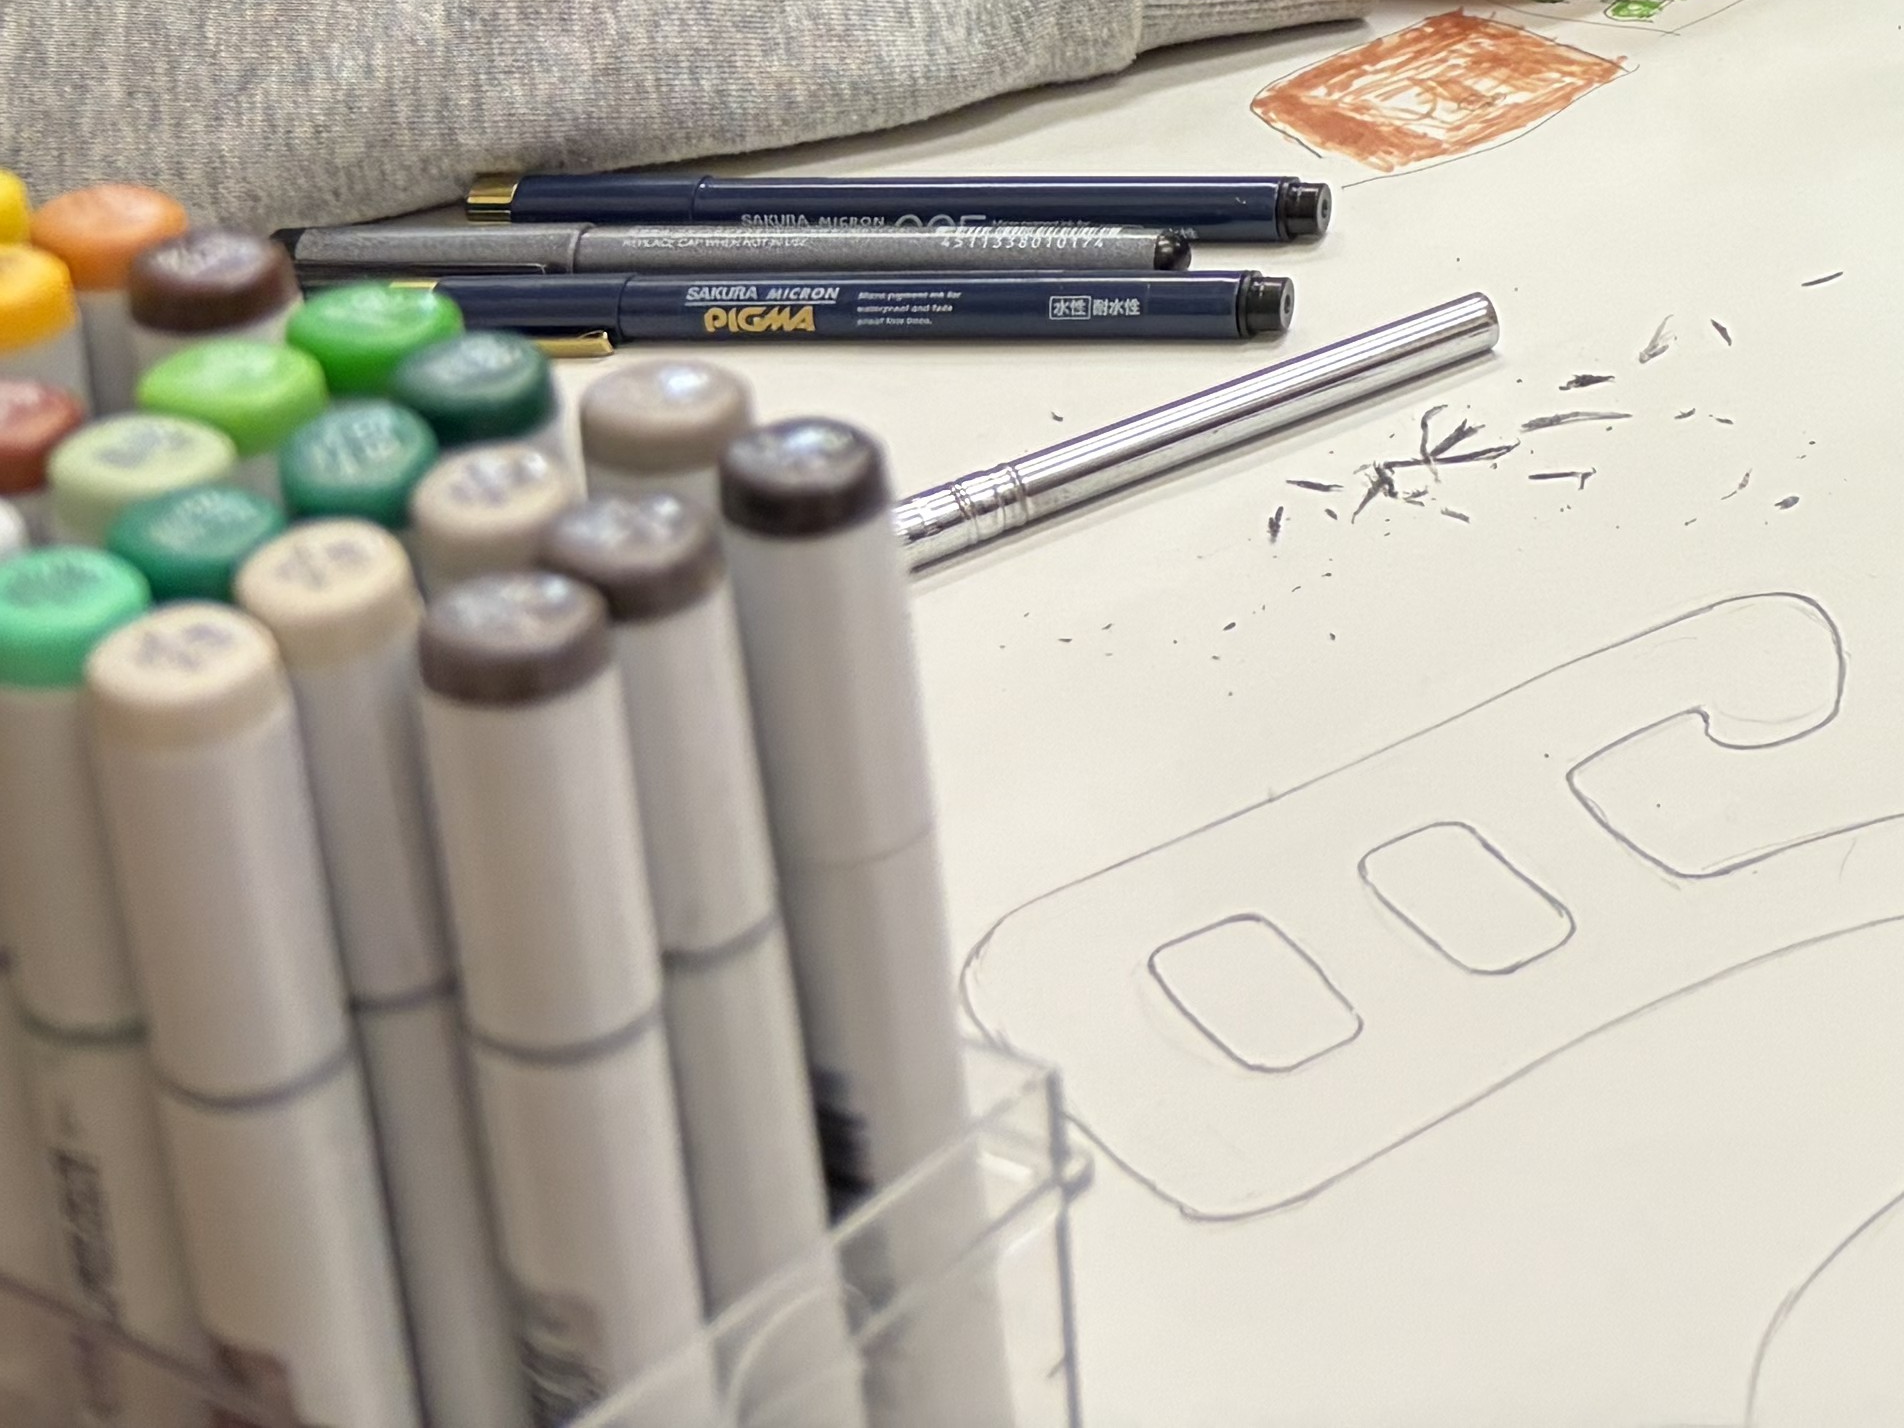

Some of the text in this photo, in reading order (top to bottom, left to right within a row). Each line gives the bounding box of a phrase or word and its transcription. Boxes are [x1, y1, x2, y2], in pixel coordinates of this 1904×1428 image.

[685, 286, 840, 301] SAKURA MICRON
[1053, 298, 1087, 316] 水性
[1093, 298, 1140, 316] 耐水性
[704, 305, 816, 333] PIGMA
